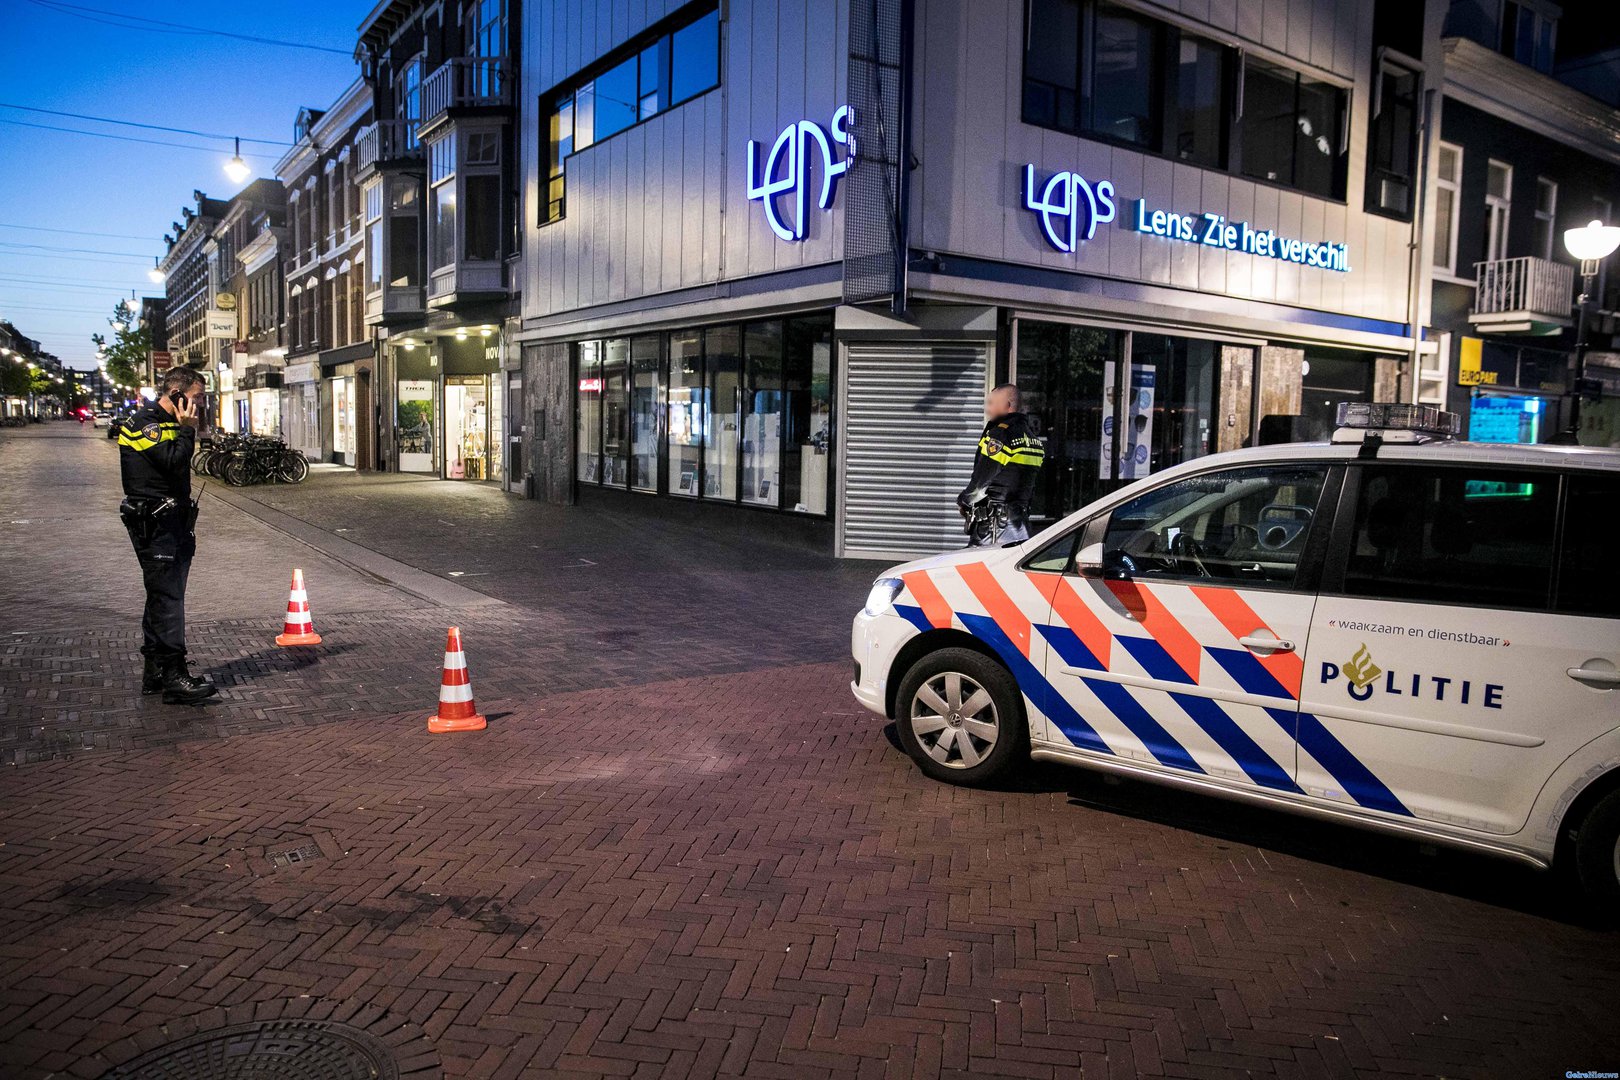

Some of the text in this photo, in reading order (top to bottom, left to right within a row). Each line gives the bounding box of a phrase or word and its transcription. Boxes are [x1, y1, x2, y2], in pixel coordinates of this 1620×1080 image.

[1137, 198, 1353, 273] Lens. Zie het verschil.
[486, 346, 499, 360] NOV
[1461, 369, 1498, 385] EUROPART
[1338, 619, 1501, 647] waakzaam en dienstbaar
[1320, 661, 1504, 709] POLITIE
